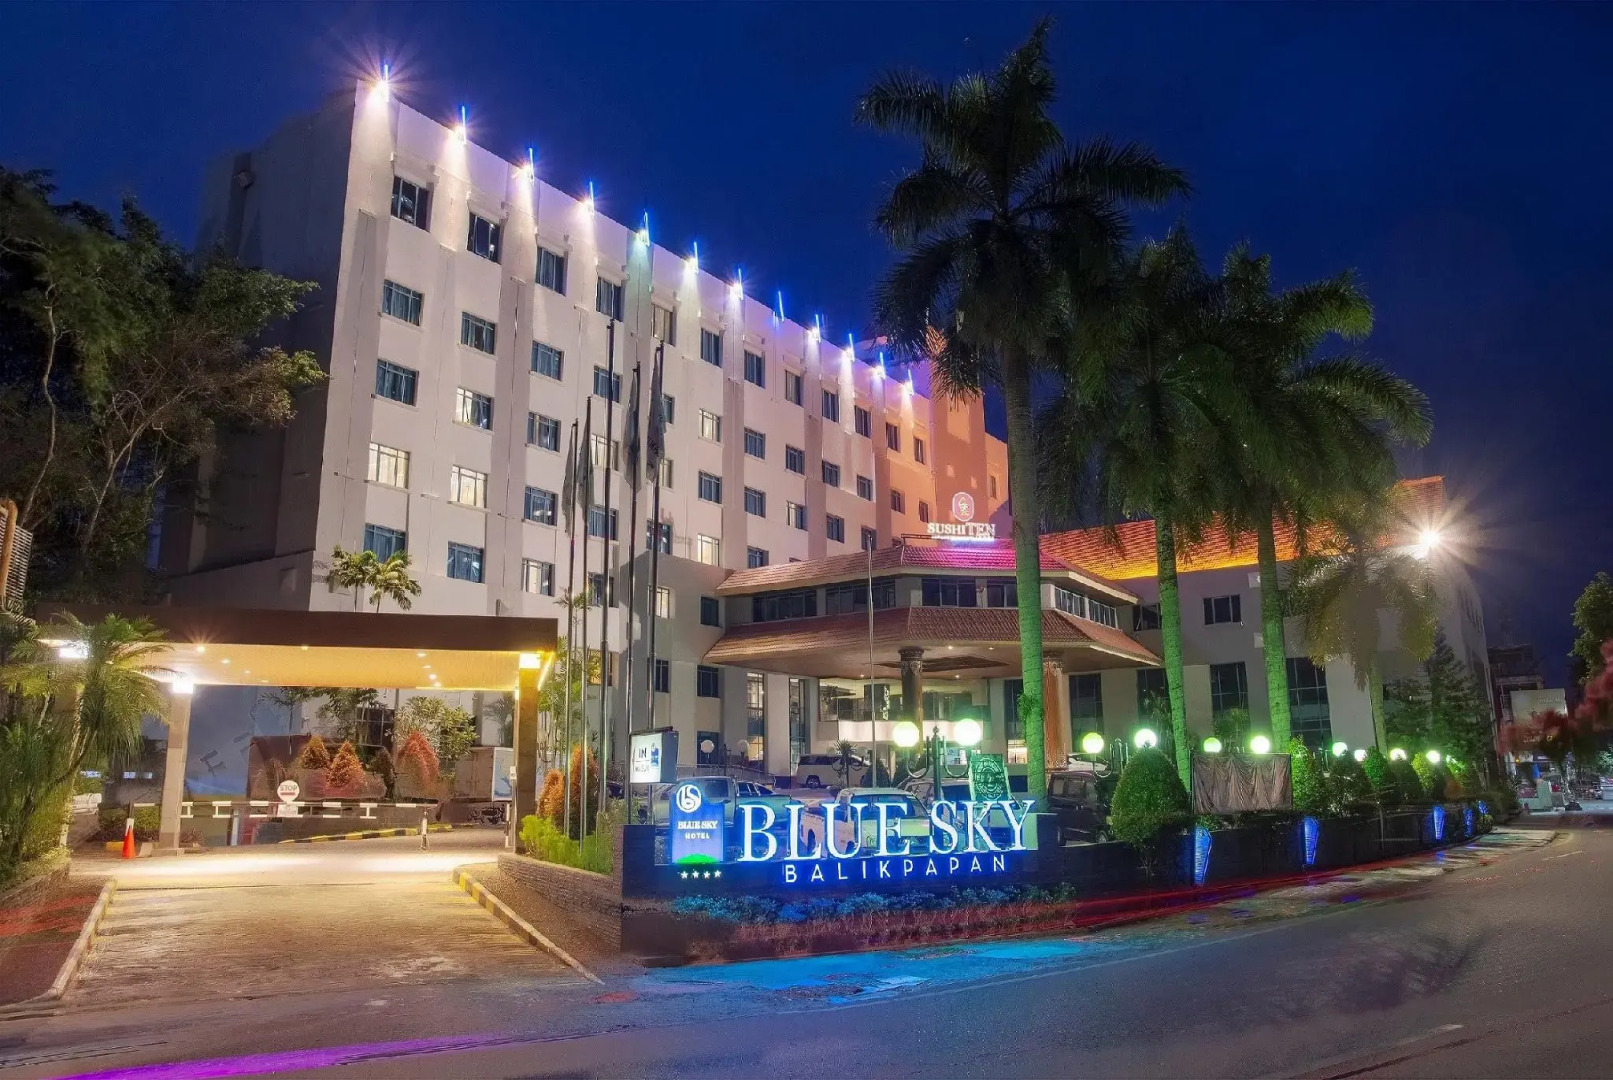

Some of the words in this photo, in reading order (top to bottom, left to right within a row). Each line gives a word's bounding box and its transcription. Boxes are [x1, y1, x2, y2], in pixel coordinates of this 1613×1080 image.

[677, 821, 700, 829] BLUE
[701, 821, 718, 829] SKY
[737, 803, 910, 861] BLUE
[929, 800, 1035, 854] SKY
[785, 854, 1005, 882] BALIKPAPAN
